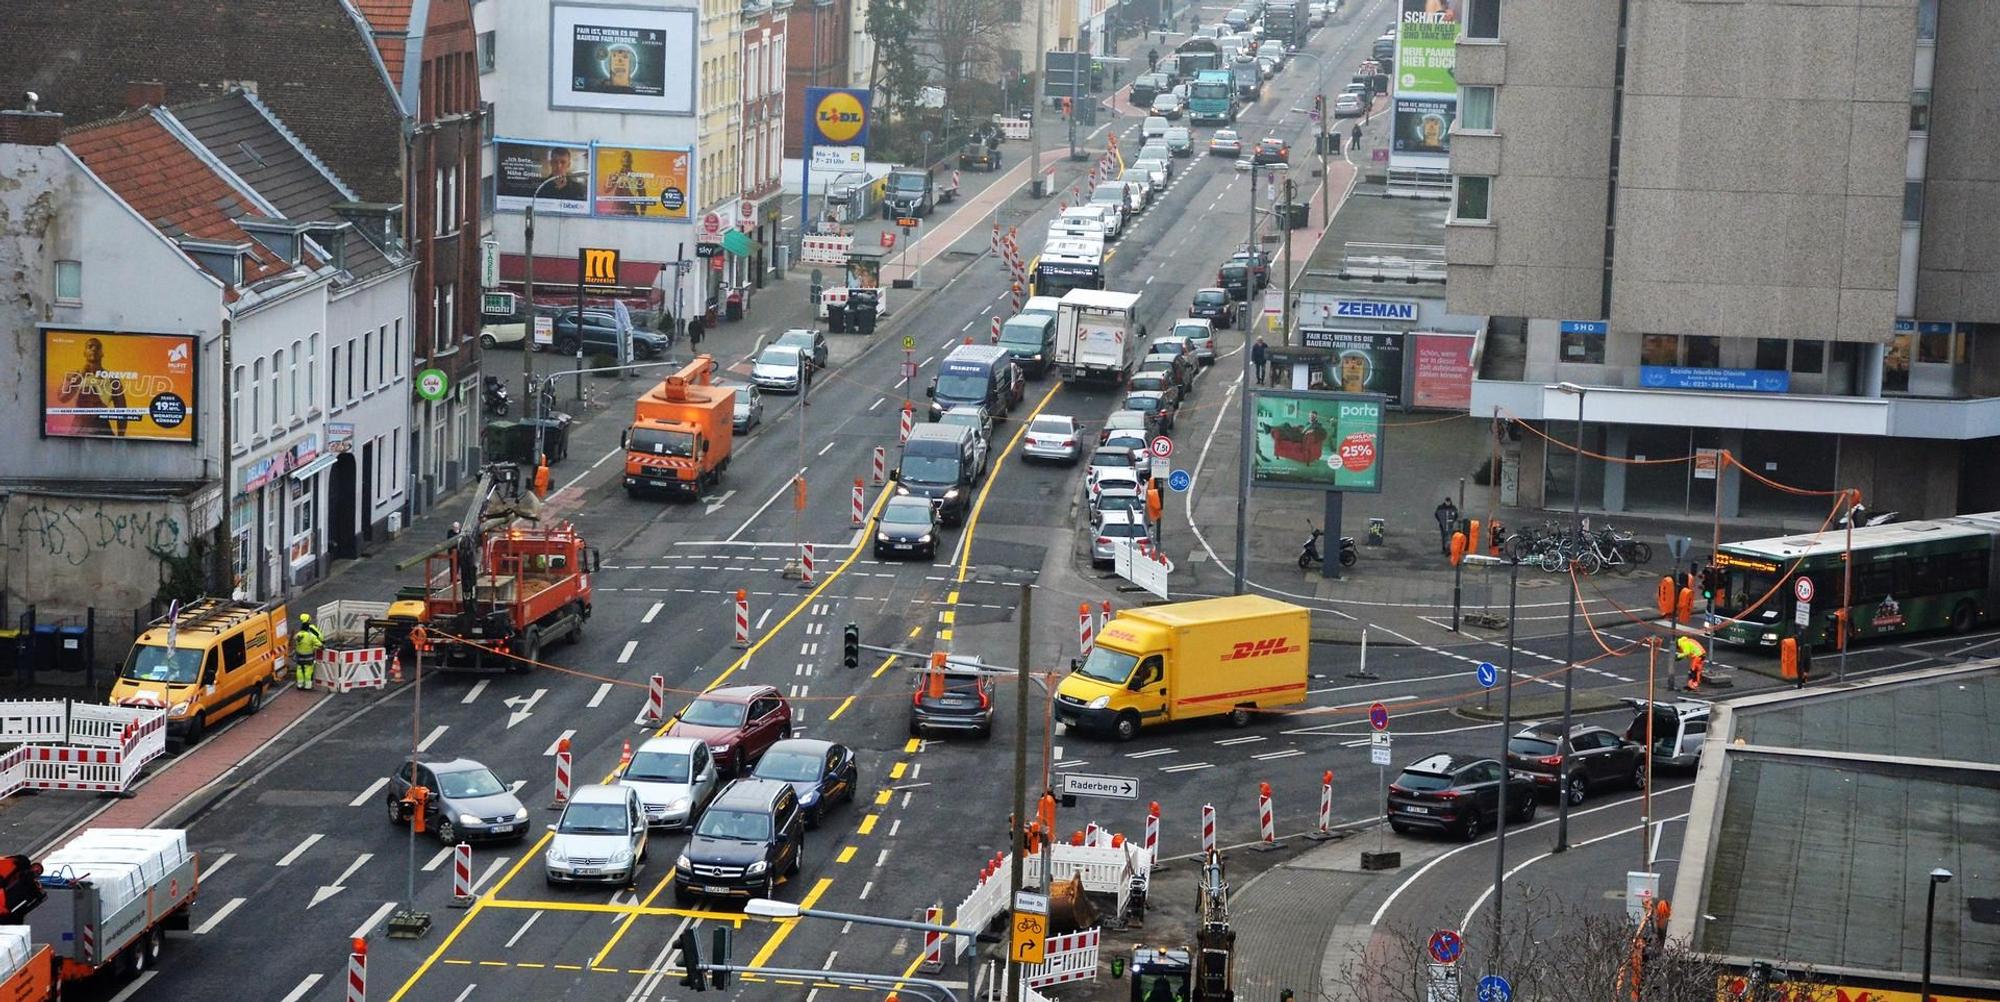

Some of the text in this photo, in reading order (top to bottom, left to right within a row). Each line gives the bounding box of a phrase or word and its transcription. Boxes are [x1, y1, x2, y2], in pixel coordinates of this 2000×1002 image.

[1338, 302, 1412, 318] ZEEMAN
[1573, 323, 1595, 331] SHD
[1306, 332, 1320, 340] FAIR
[95, 370, 139, 380] FOREVER
[62, 372, 174, 397] PROUD
[1341, 403, 1379, 418] porta
[1342, 444, 1373, 458] 25%
[1232, 637, 1289, 660] DHL
[1070, 780, 1118, 793] Raderberg
